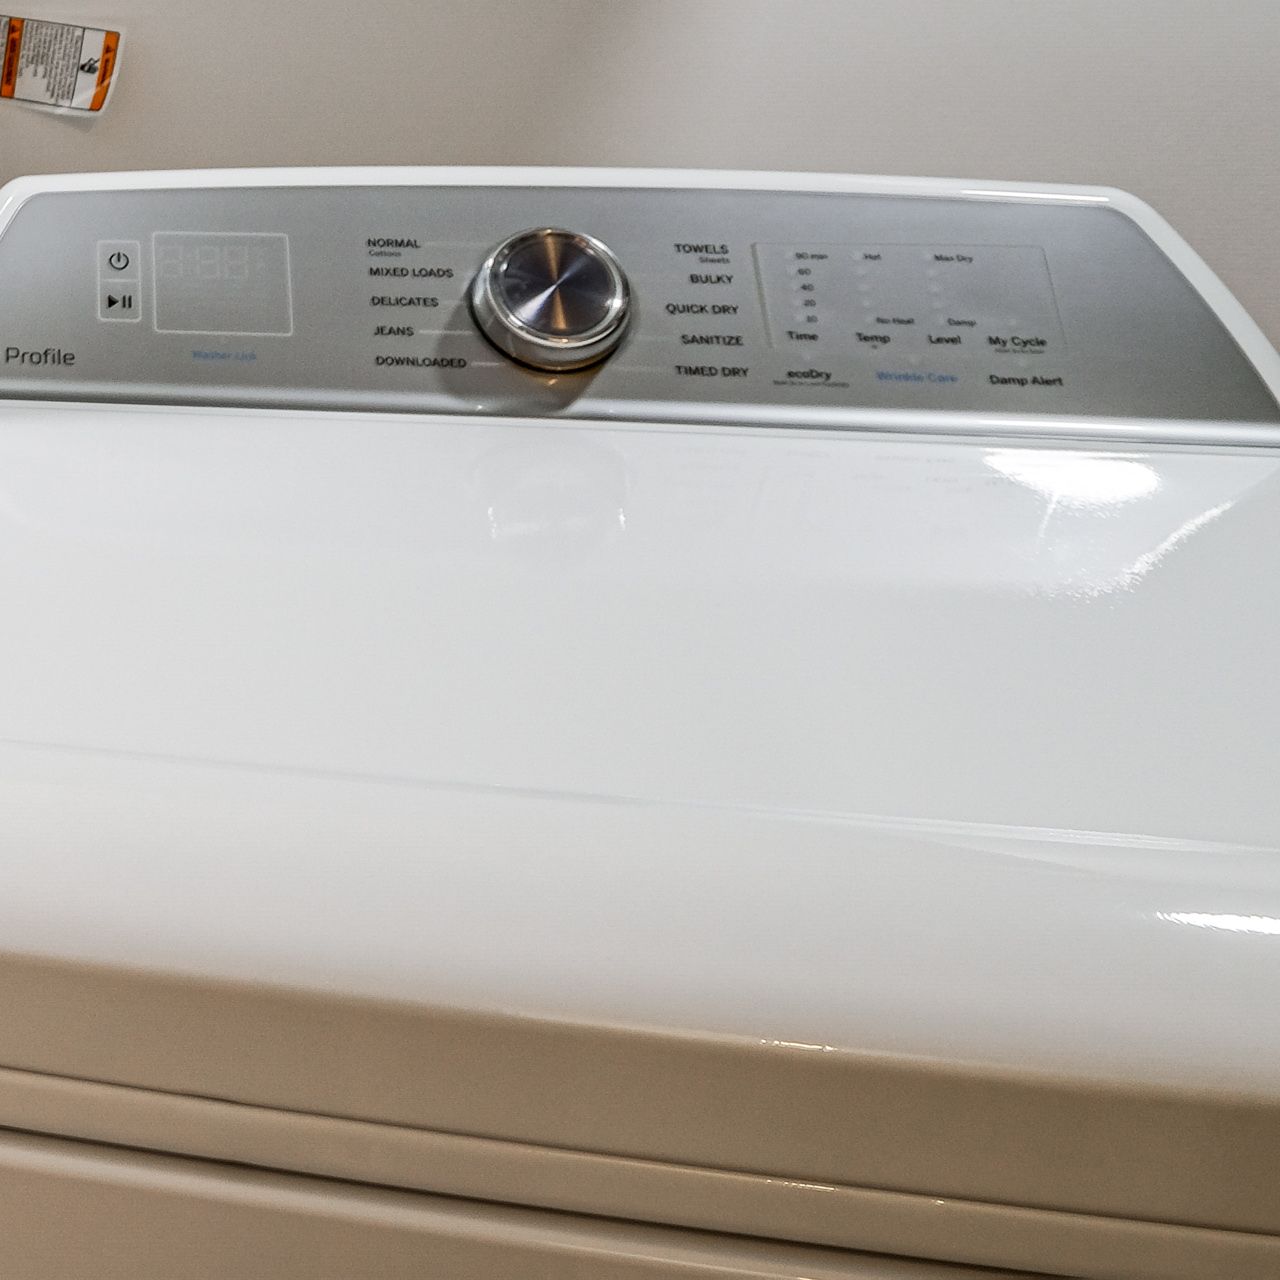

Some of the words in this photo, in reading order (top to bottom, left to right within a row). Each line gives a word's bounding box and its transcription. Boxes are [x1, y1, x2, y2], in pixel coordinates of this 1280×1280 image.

[367, 238, 421, 248] NORMAL
[674, 243, 729, 255] TOWELS
[369, 267, 409, 278] MIXED
[412, 268, 454, 279] LOADS
[690, 274, 734, 284] BULKY
[370, 296, 439, 307] DELICATES
[665, 303, 708, 315] QUICK
[712, 305, 739, 315] DRY
[374, 326, 415, 336] JEANS
[787, 330, 819, 341] Time
[681, 334, 744, 346] SANITIZE
[856, 331, 891, 344] Temp
[928, 334, 962, 345] Level
[988, 335, 1008, 348] My
[1011, 335, 1048, 348] Cycle
[5, 347, 75, 366] Profile
[375, 356, 467, 368] DOWNLOADED
[674, 365, 718, 377] TIMED
[721, 367, 749, 377] DRY
[787, 369, 832, 382] ecoDry
[990, 375, 1028, 387] Damp
[1032, 376, 1064, 387] Alert
